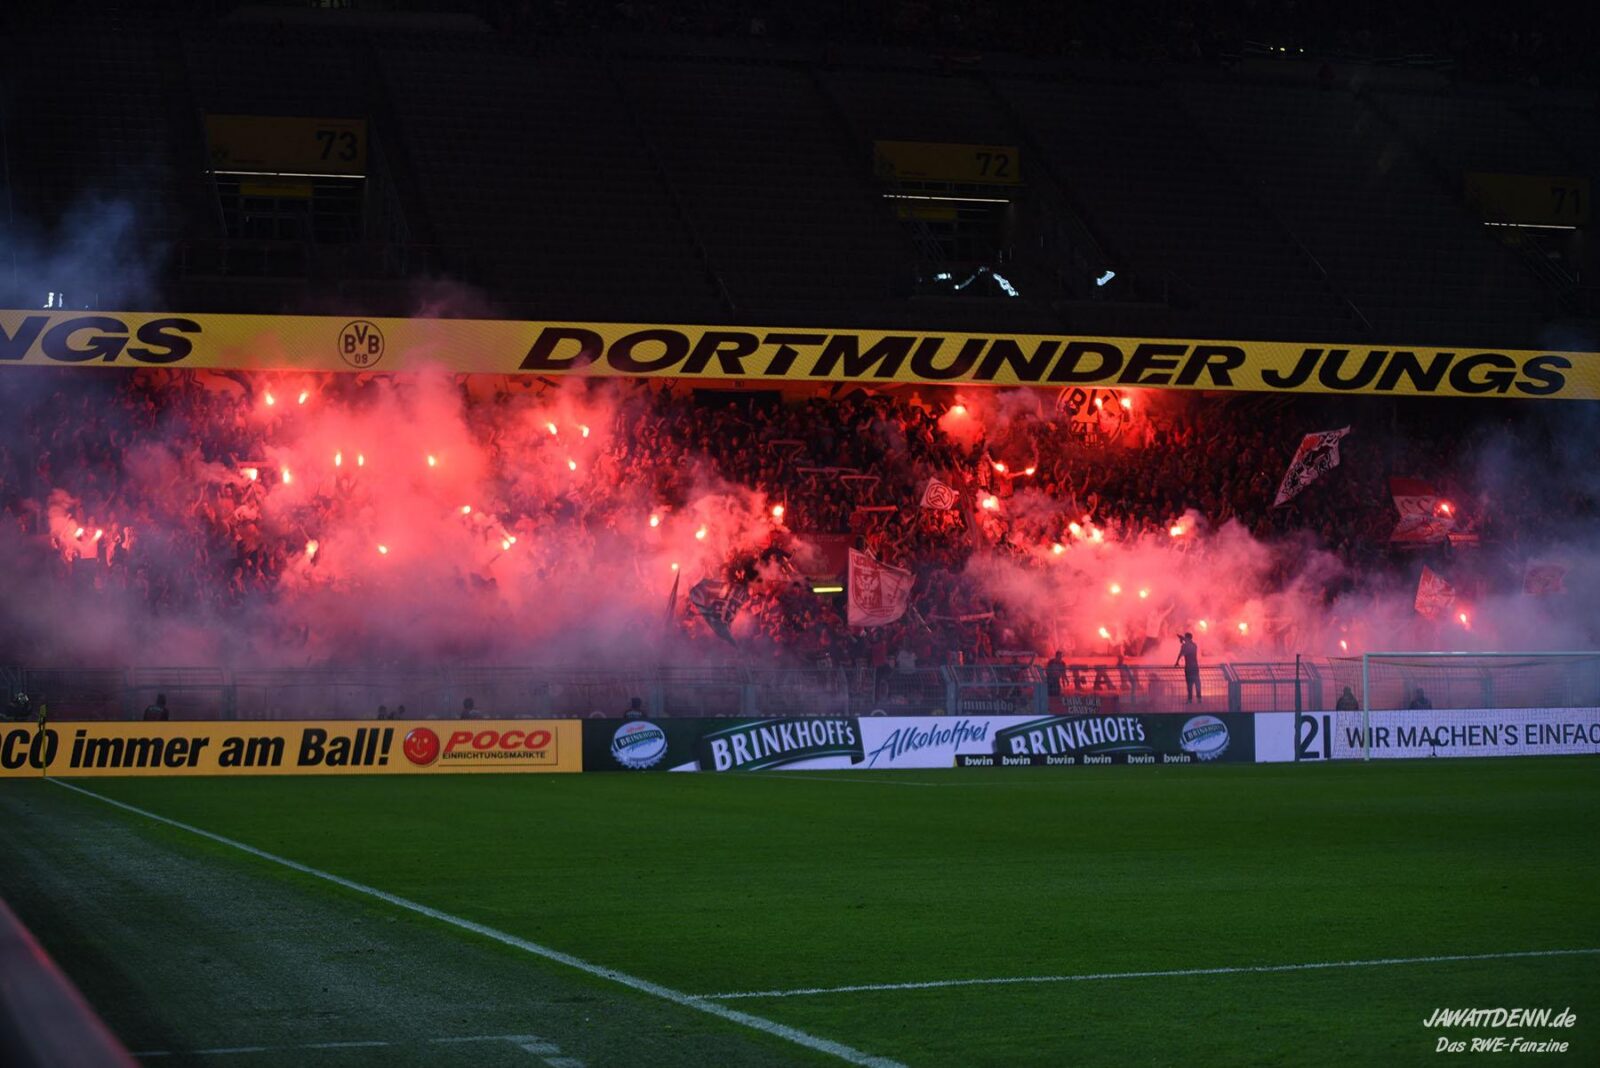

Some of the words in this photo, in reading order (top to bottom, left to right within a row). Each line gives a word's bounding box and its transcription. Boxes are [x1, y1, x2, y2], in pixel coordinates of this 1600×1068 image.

[316, 130, 357, 161] 73
[976, 153, 1009, 176] 72
[1552, 187, 1580, 214] 71
[344, 325, 380, 354] BVB
[354, 353, 368, 364] 09
[519, 327, 1245, 386] DORTMUNDER
[1261, 349, 1572, 395] JUNGS
[0, 729, 58, 769] CO
[70, 729, 209, 768] immer
[218, 737, 285, 767] am
[297, 727, 394, 766] Ball!
[444, 730, 551, 753] POCO
[867, 719, 990, 769] Alkoholfrei
[1346, 726, 1390, 748] WIR
[442, 751, 545, 760] EINRICHTUNGSMARKTE
[965, 756, 994, 766] bwin
[1002, 756, 1031, 766] bwin
[1047, 755, 1075, 765] bwin
[1083, 754, 1112, 764] bwin
[1128, 753, 1155, 764] bwin
[1163, 752, 1191, 763] bwin
